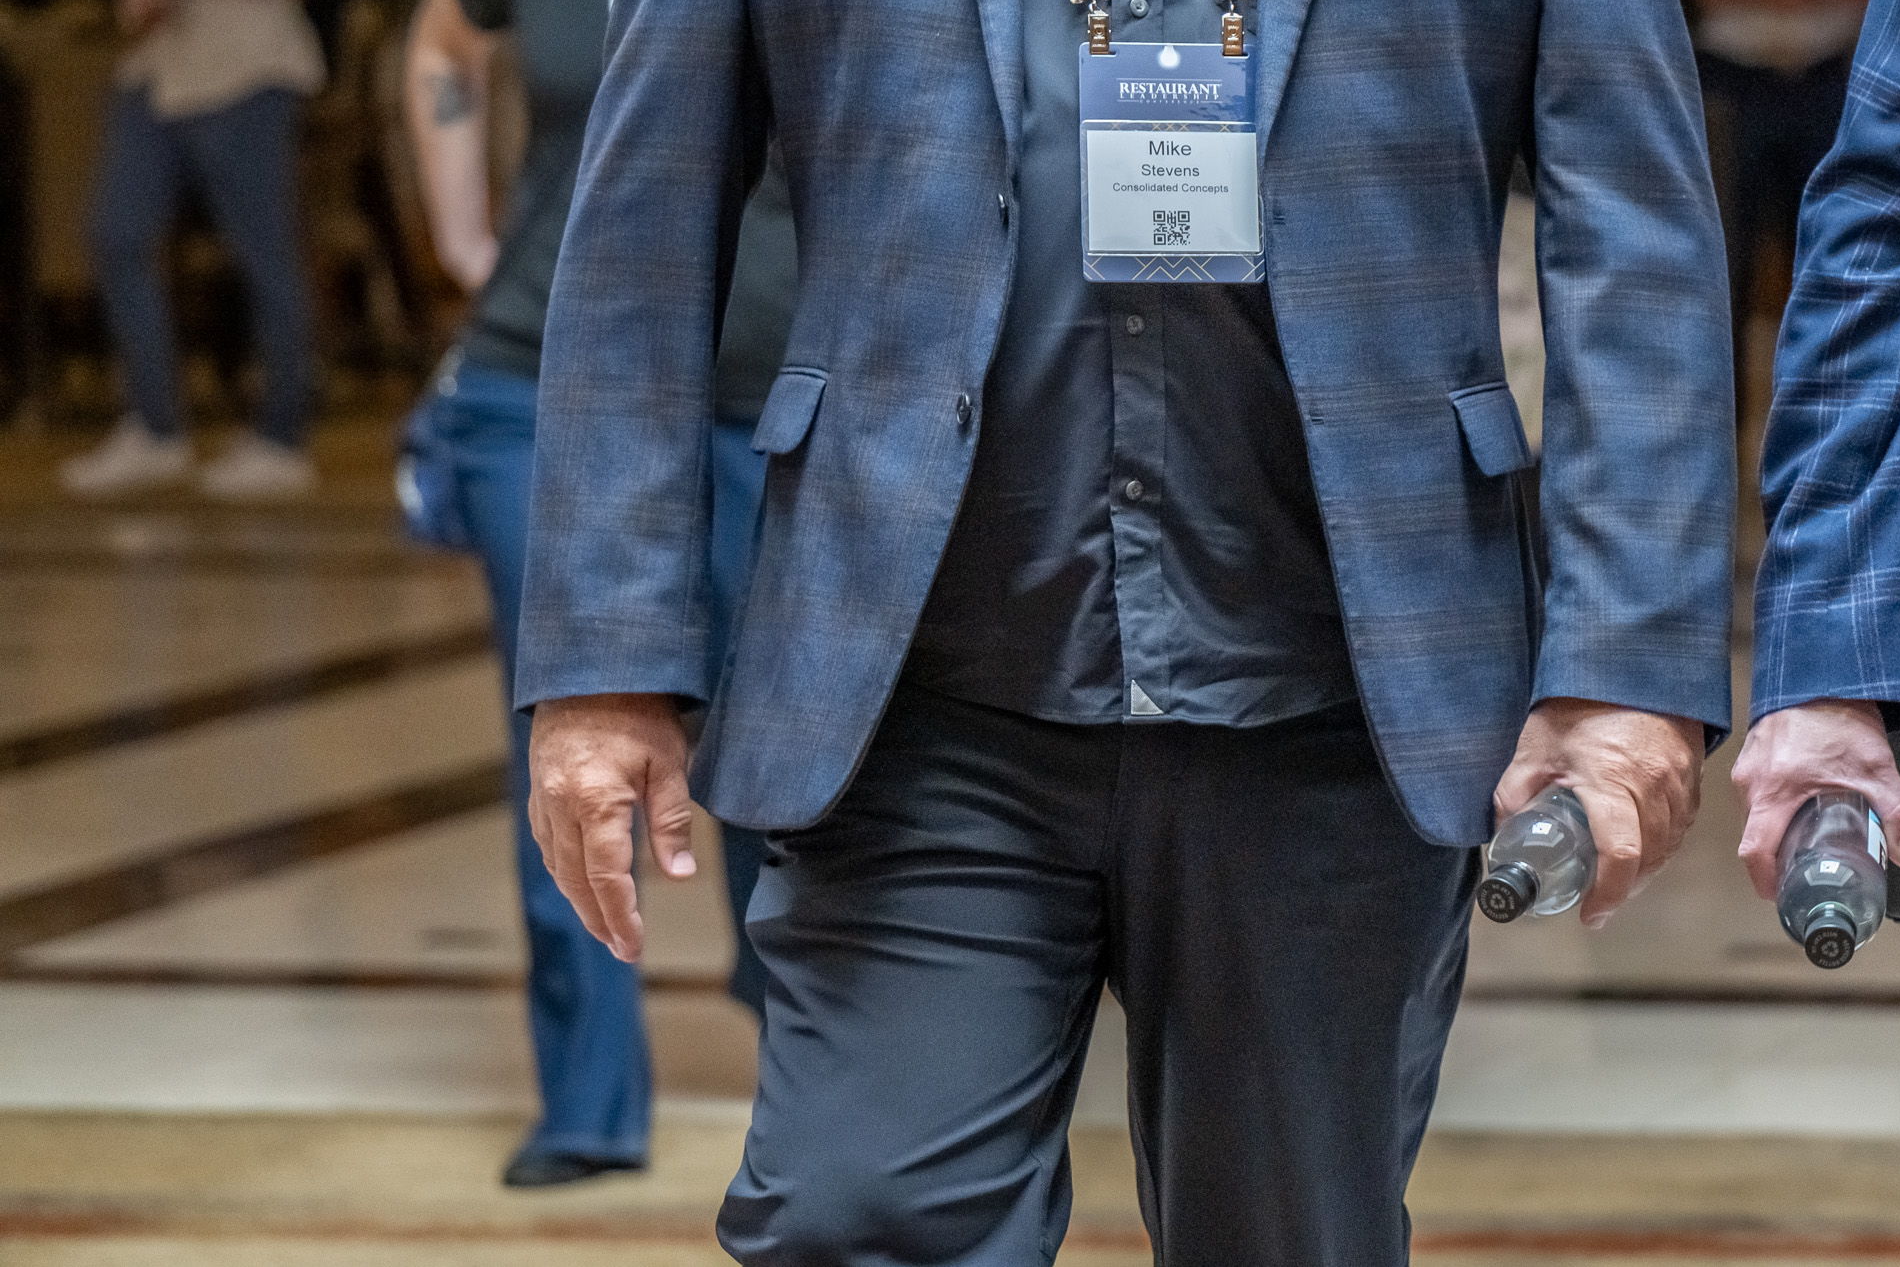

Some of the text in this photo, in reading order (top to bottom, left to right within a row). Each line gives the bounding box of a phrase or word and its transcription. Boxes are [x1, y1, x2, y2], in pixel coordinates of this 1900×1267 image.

[1119, 82, 1220, 95] RESTAURANT
[1149, 140, 1192, 156] Mike
[1141, 163, 1200, 177] Stevens
[1112, 182, 1229, 194] Consolidated Concepts
